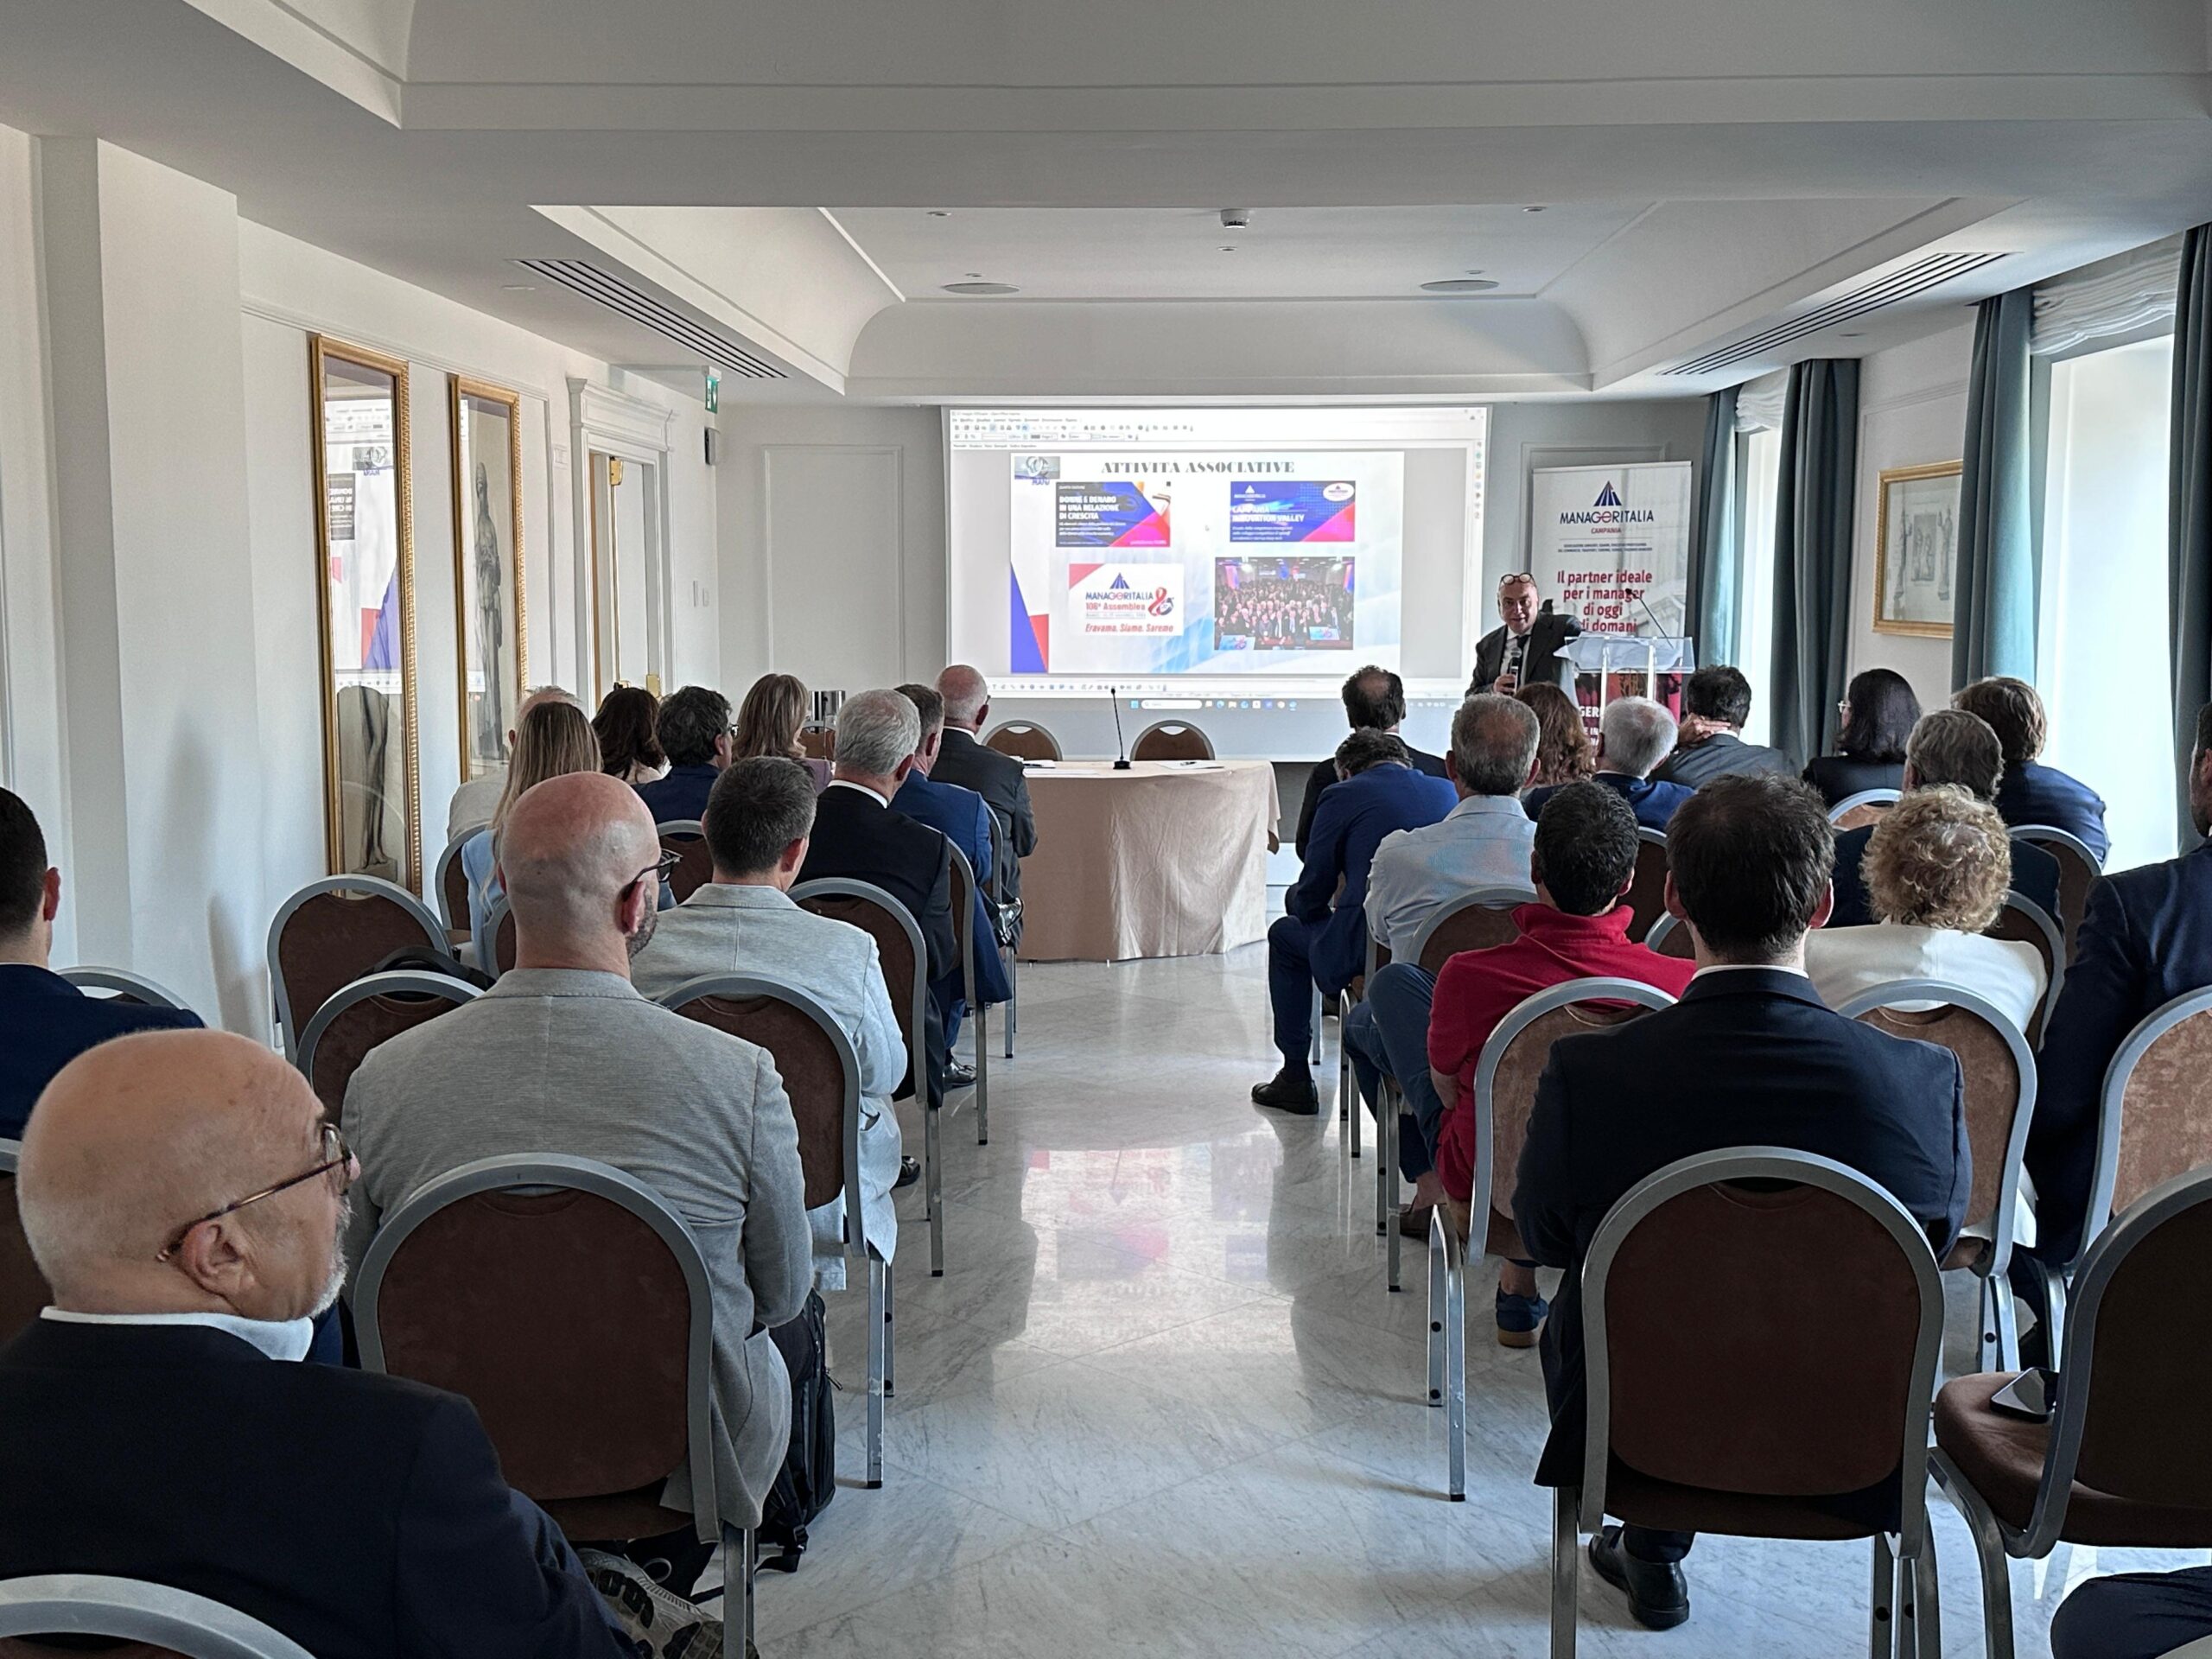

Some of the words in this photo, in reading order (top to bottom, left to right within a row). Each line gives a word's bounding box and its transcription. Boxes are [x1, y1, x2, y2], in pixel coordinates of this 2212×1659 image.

[1185, 461, 1294, 473] ASSOCIATIVE
[1557, 570, 1565, 583] Il
[1567, 570, 1612, 586] partner
[1616, 569, 1652, 583] ideale
[1563, 589, 1584, 602] per
[1586, 586, 1590, 599] i
[1583, 602, 1594, 615] di
[1597, 602, 1623, 619] oggi
[1146, 623, 1174, 632] Saremo
[1592, 618, 1637, 632] domani
